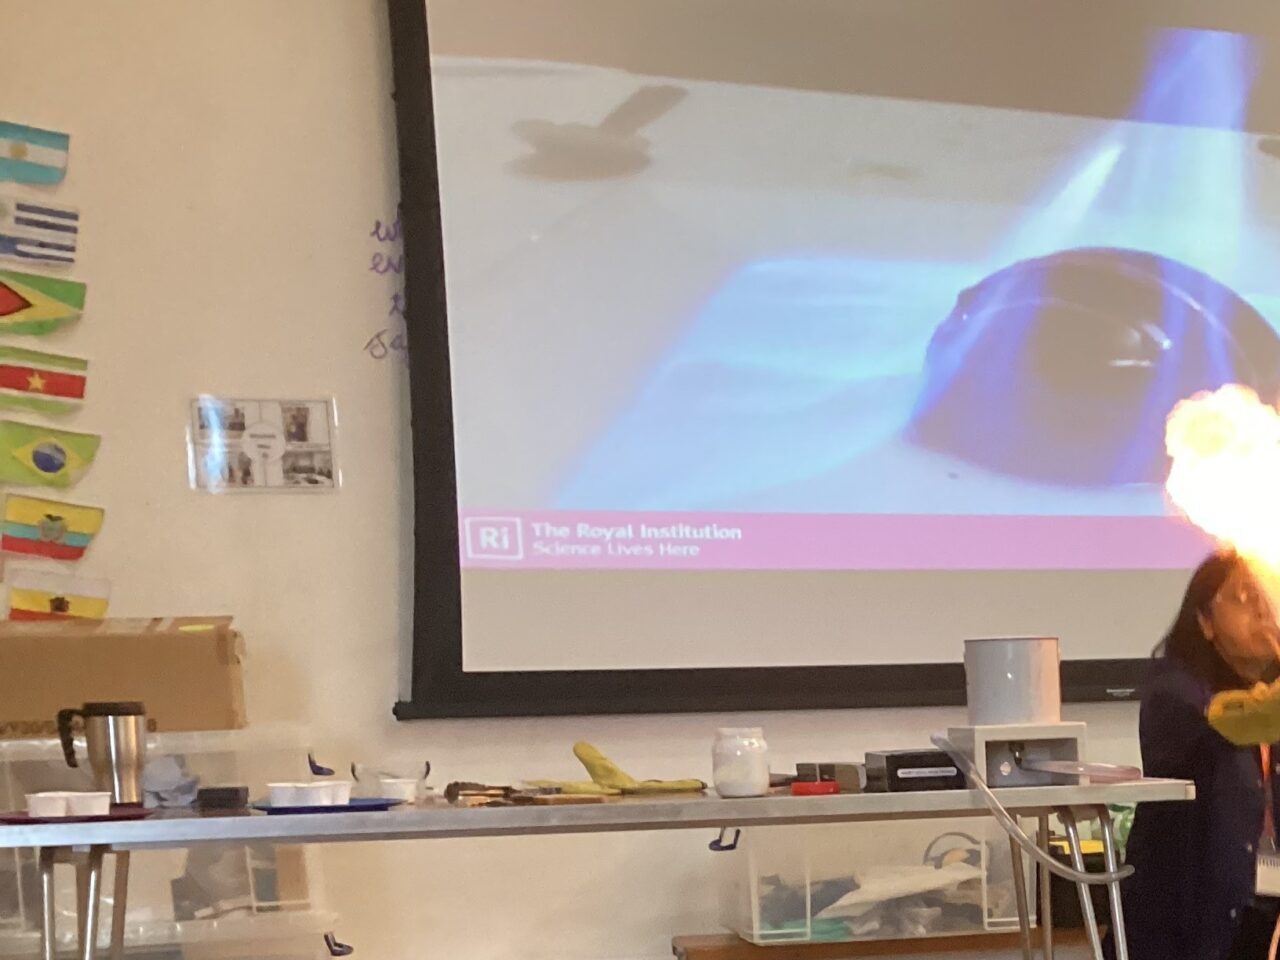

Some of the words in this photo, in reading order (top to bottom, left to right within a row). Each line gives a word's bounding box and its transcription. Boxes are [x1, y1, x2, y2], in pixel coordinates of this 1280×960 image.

[479, 526, 509, 549] Ri
[531, 522, 570, 538] The
[577, 522, 633, 541] Royal
[640, 523, 743, 540] Institution
[533, 540, 601, 556] Science
[607, 542, 655, 556] Lives
[659, 543, 700, 557] Here
